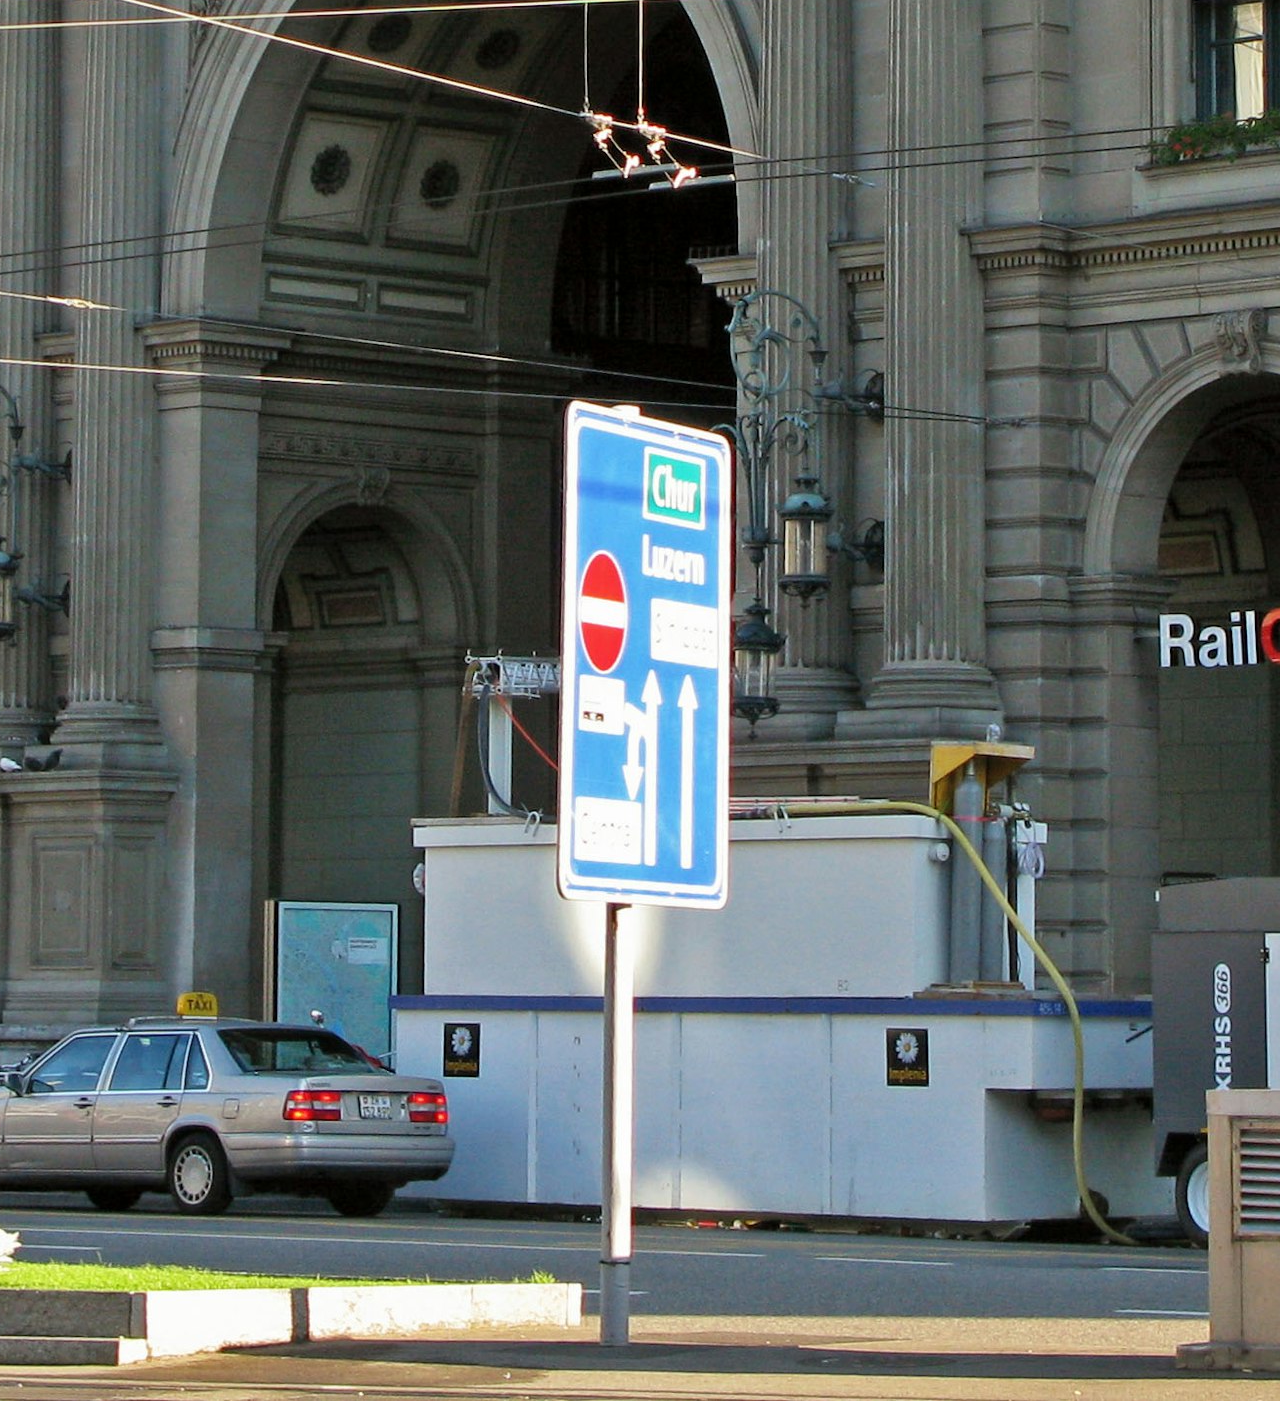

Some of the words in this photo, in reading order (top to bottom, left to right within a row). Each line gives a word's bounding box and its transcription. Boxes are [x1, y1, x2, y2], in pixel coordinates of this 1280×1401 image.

[652, 464, 698, 513] Chur
[642, 534, 705, 586] Luzern
[186, 999, 212, 1011] TAXI
[1216, 969, 1229, 1009] 366
[1214, 1016, 1232, 1091] XRHS
